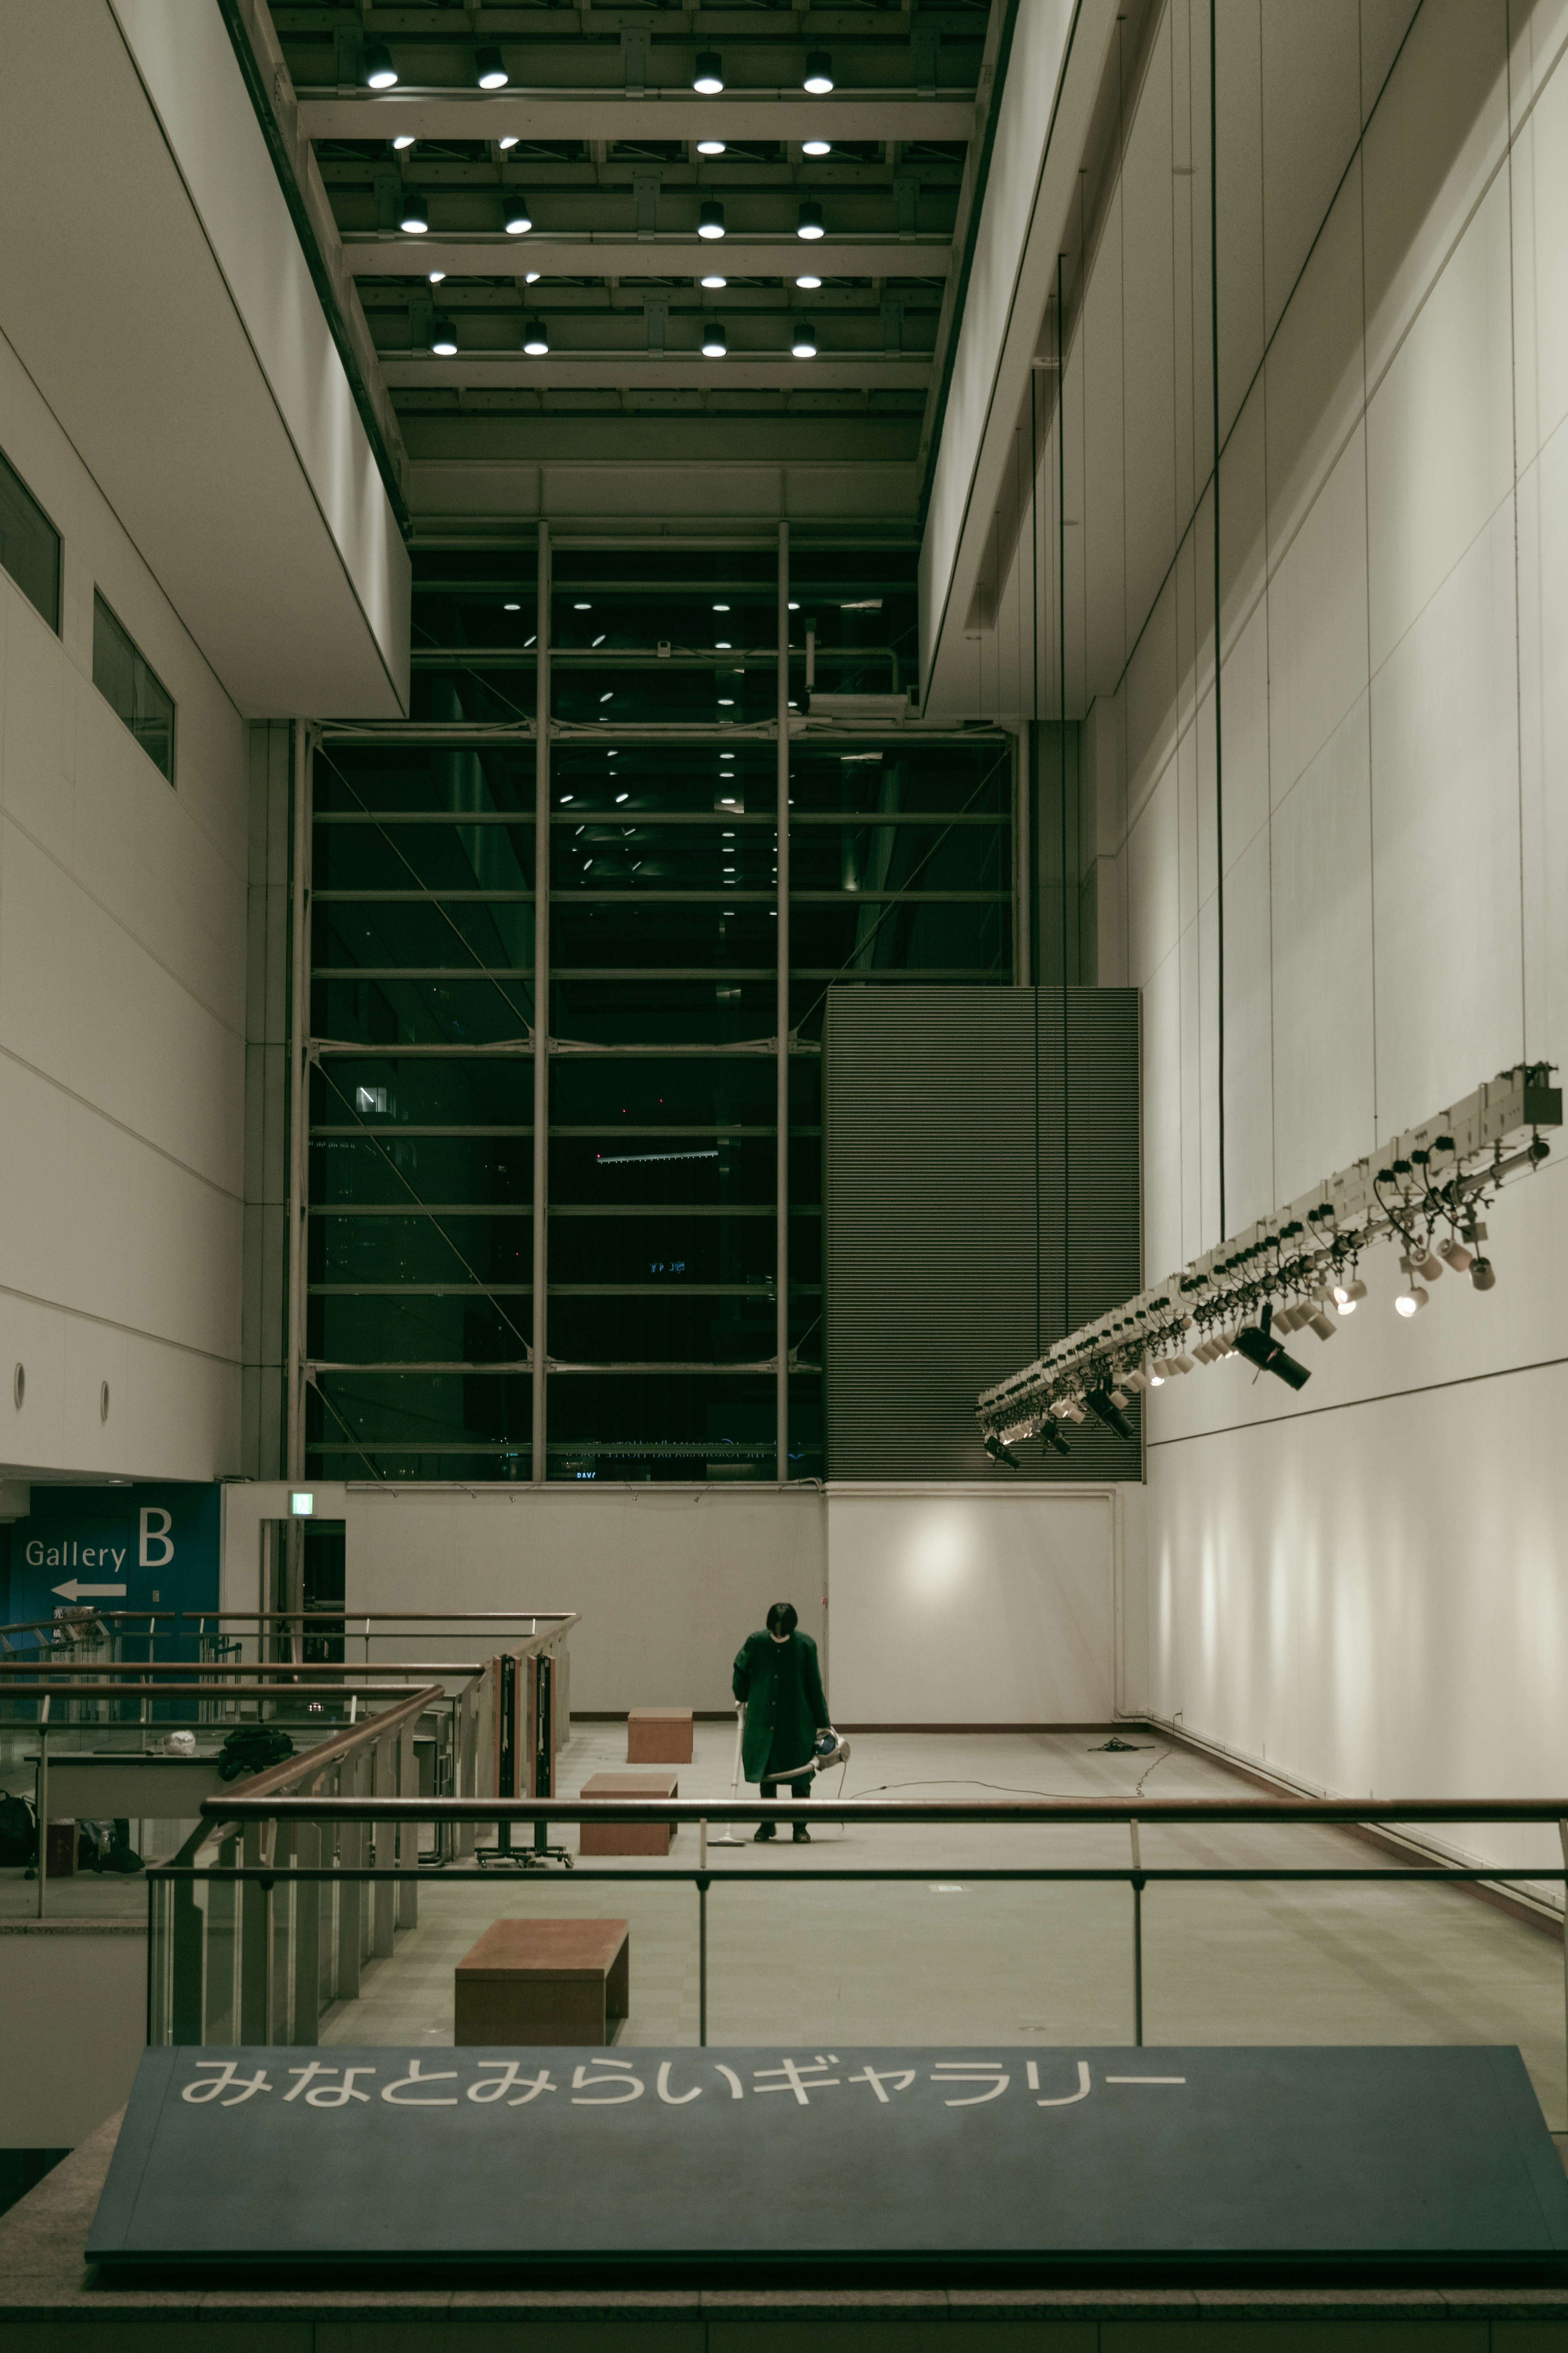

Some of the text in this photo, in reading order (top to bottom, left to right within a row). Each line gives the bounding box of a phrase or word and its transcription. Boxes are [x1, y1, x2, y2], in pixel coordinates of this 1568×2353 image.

[26, 1507, 175, 1572] Gallery B
[182, 2054, 1186, 2108] みなとみらいギャラリー
